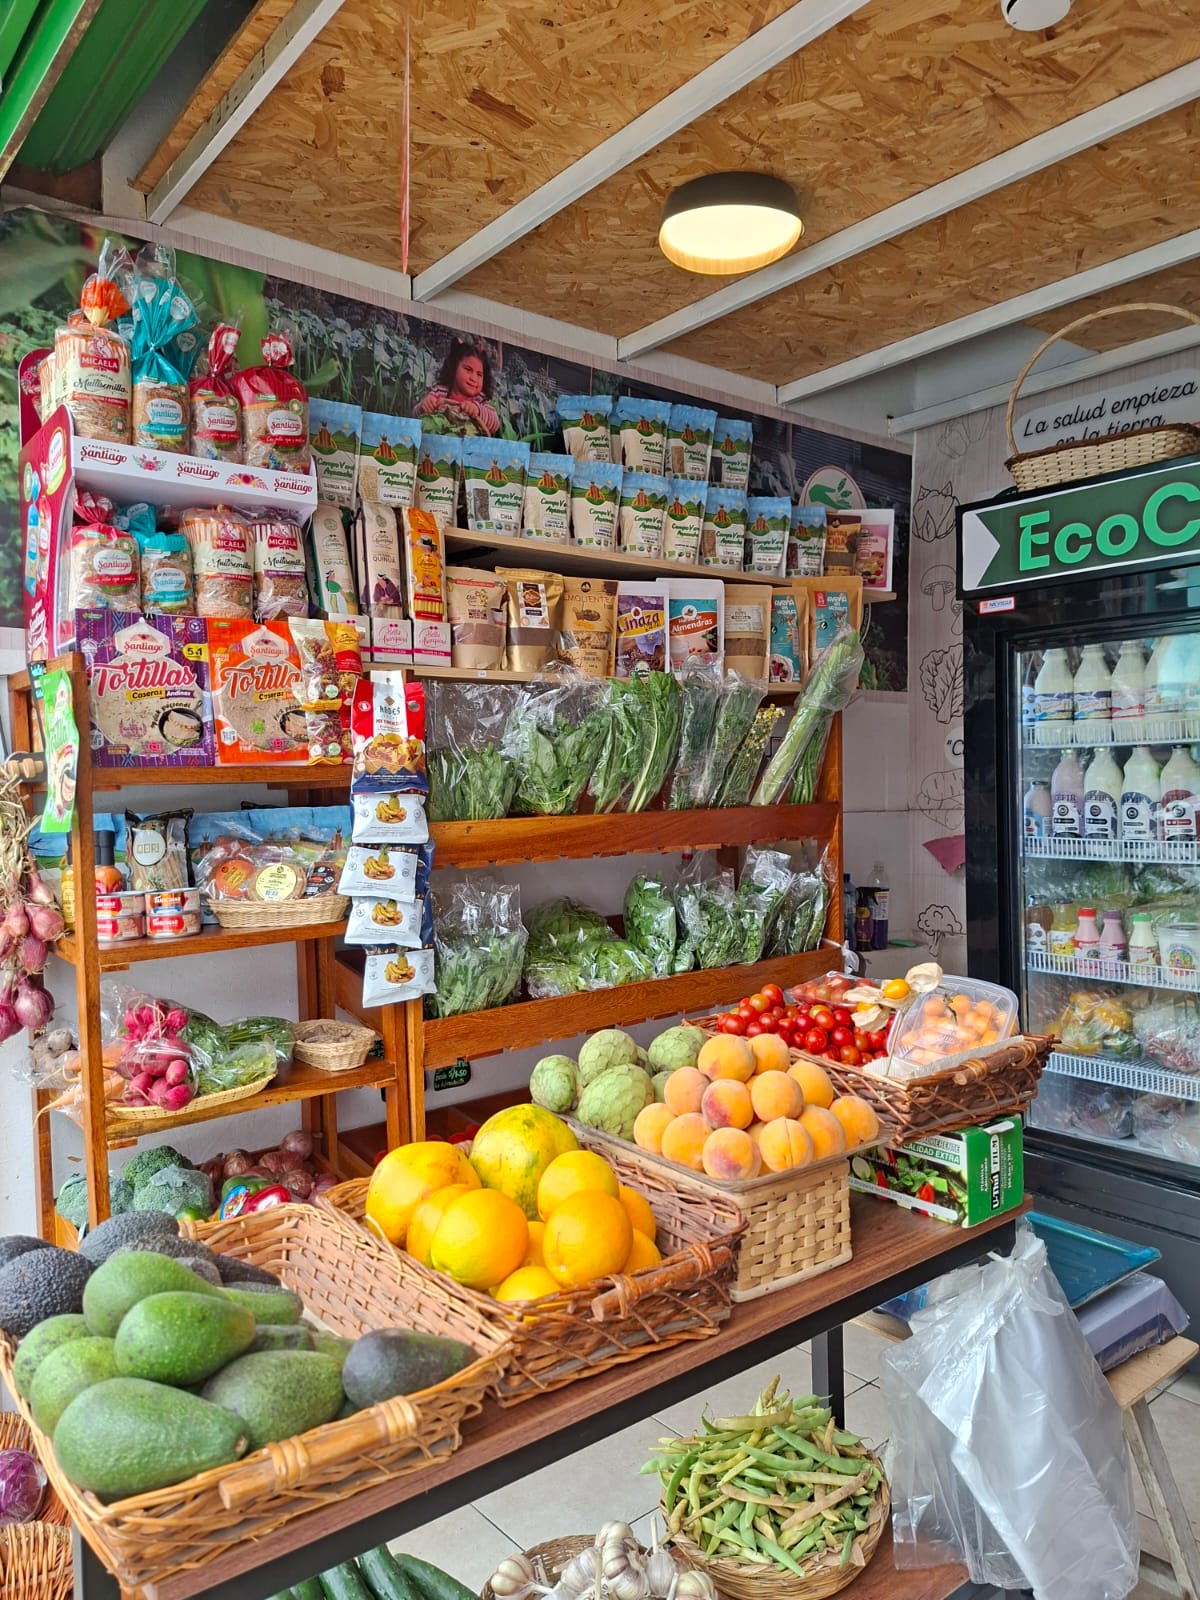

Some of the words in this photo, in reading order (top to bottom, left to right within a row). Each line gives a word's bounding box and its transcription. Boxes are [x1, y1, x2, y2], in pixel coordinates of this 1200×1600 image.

[82, 356, 118, 370] MICAELA
[1023, 419, 1048, 437] La
[1053, 398, 1106, 429] salud
[1111, 380, 1197, 415] empieza
[1107, 414, 1166, 433] tierra
[80, 445, 127, 465] Santiago
[177, 461, 220, 480] Santiago
[274, 478, 313, 495] Santiago
[216, 539, 246, 550] MICAELA
[268, 538, 297, 548] MICAELA
[617, 612, 660, 634] Linaza
[671, 617, 713, 633] Almendras
[124, 640, 163, 654] Santiago
[251, 646, 282, 657] Santiago
[87, 657, 196, 697] Tortillas
[132, 689, 163, 699] Caseras
[934, 1150, 961, 1164] EXTRA
[991, 1139, 999, 1165] FILM
